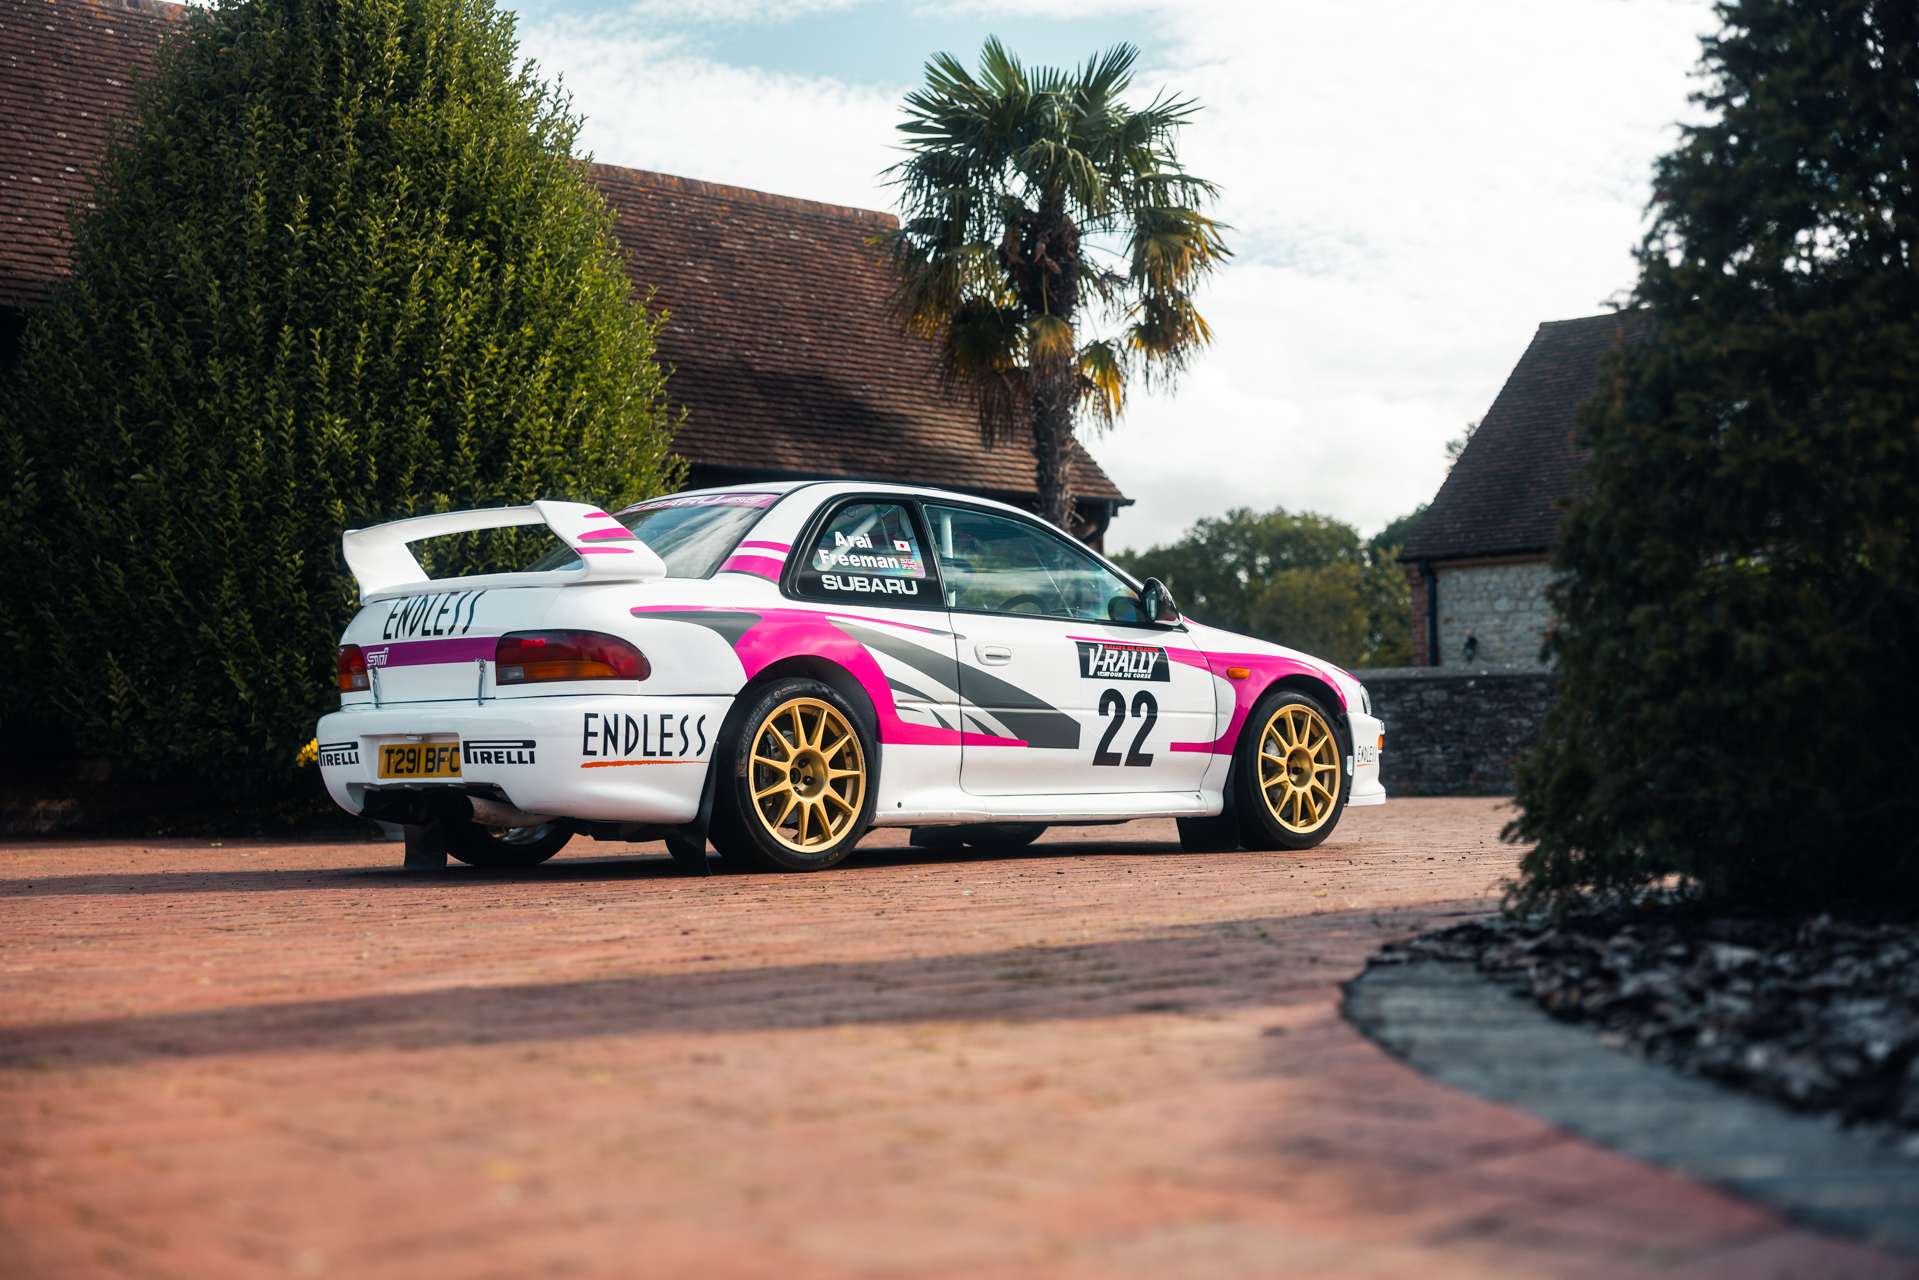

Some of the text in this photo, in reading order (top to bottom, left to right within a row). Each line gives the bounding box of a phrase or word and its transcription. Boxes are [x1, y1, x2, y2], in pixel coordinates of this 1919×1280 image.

[834, 531, 873, 549] Arai
[818, 549, 900, 569] Freeman
[821, 574, 918, 595] SUBARU
[383, 590, 488, 640] ENDLESS
[1088, 644, 1159, 676] V-RALLY
[583, 712, 707, 757] ENDLESS
[1092, 688, 1158, 766] 22
[384, 747, 422, 774] T291
[463, 740, 536, 765] PIRELLI
